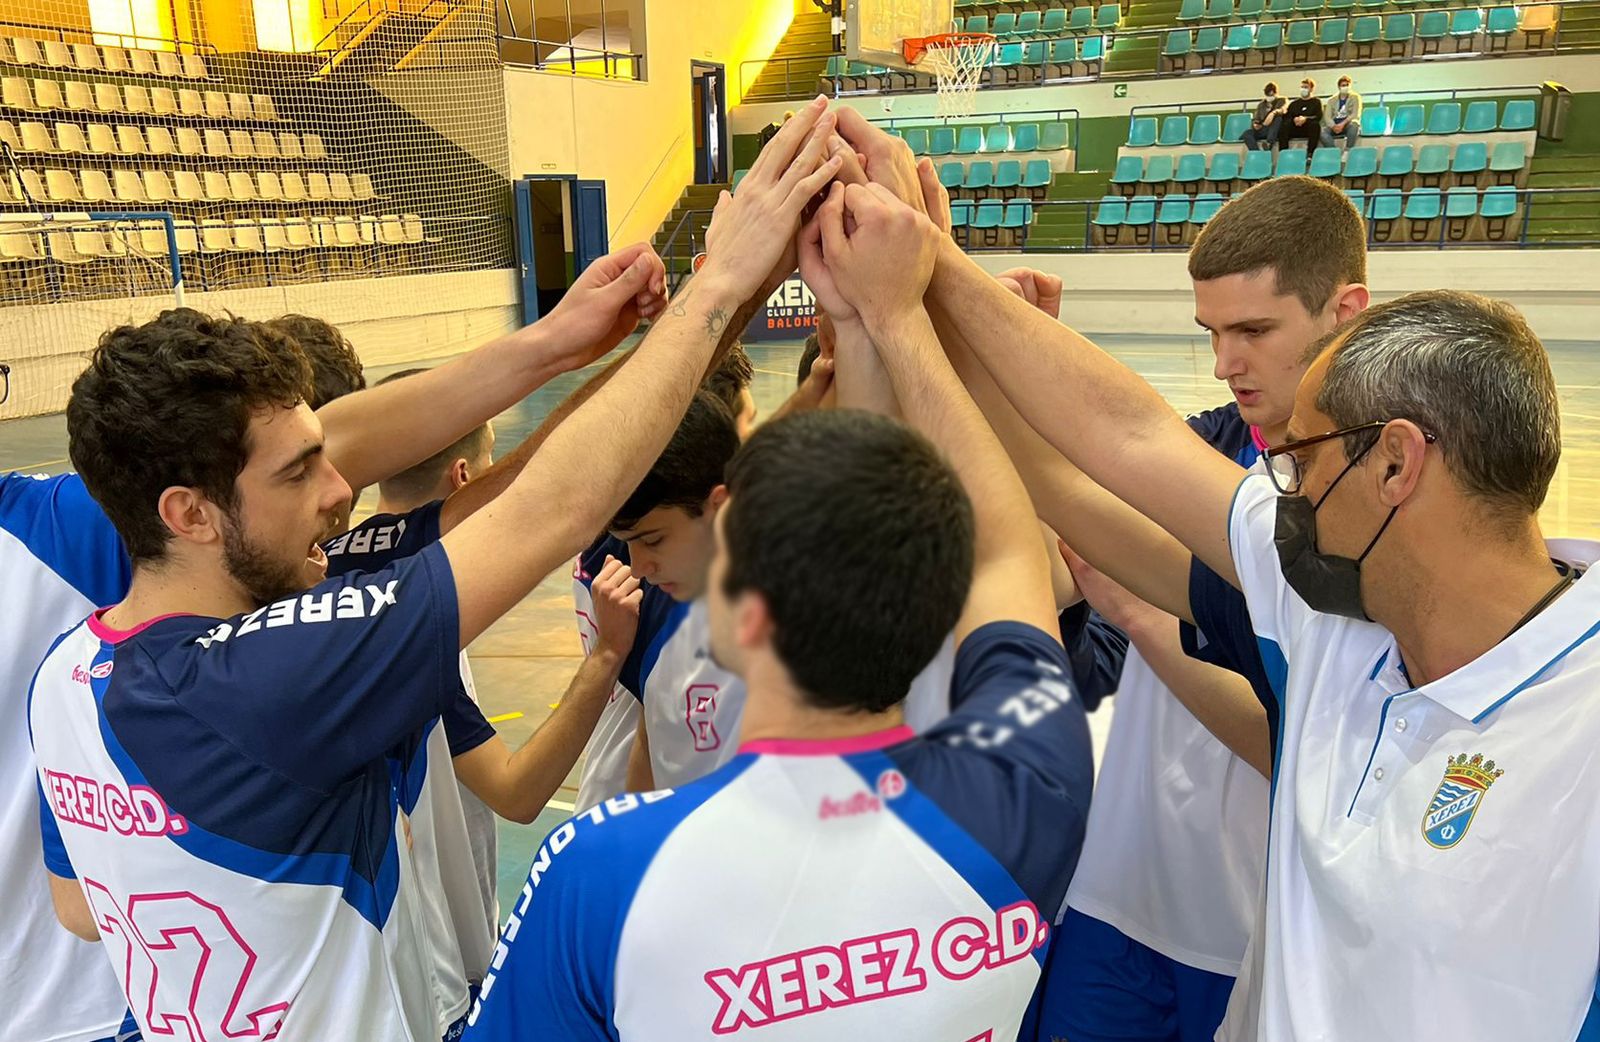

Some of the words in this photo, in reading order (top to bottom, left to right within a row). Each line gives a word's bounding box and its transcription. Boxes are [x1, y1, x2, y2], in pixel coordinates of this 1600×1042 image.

[767, 308, 793, 317] CLUB
[236, 580, 398, 637] XEREZ
[44, 768, 107, 832] EREZ
[1430, 792, 1478, 826] XEREZ
[704, 928, 927, 1035] XEREZ
[931, 901, 1049, 981] C.D.
